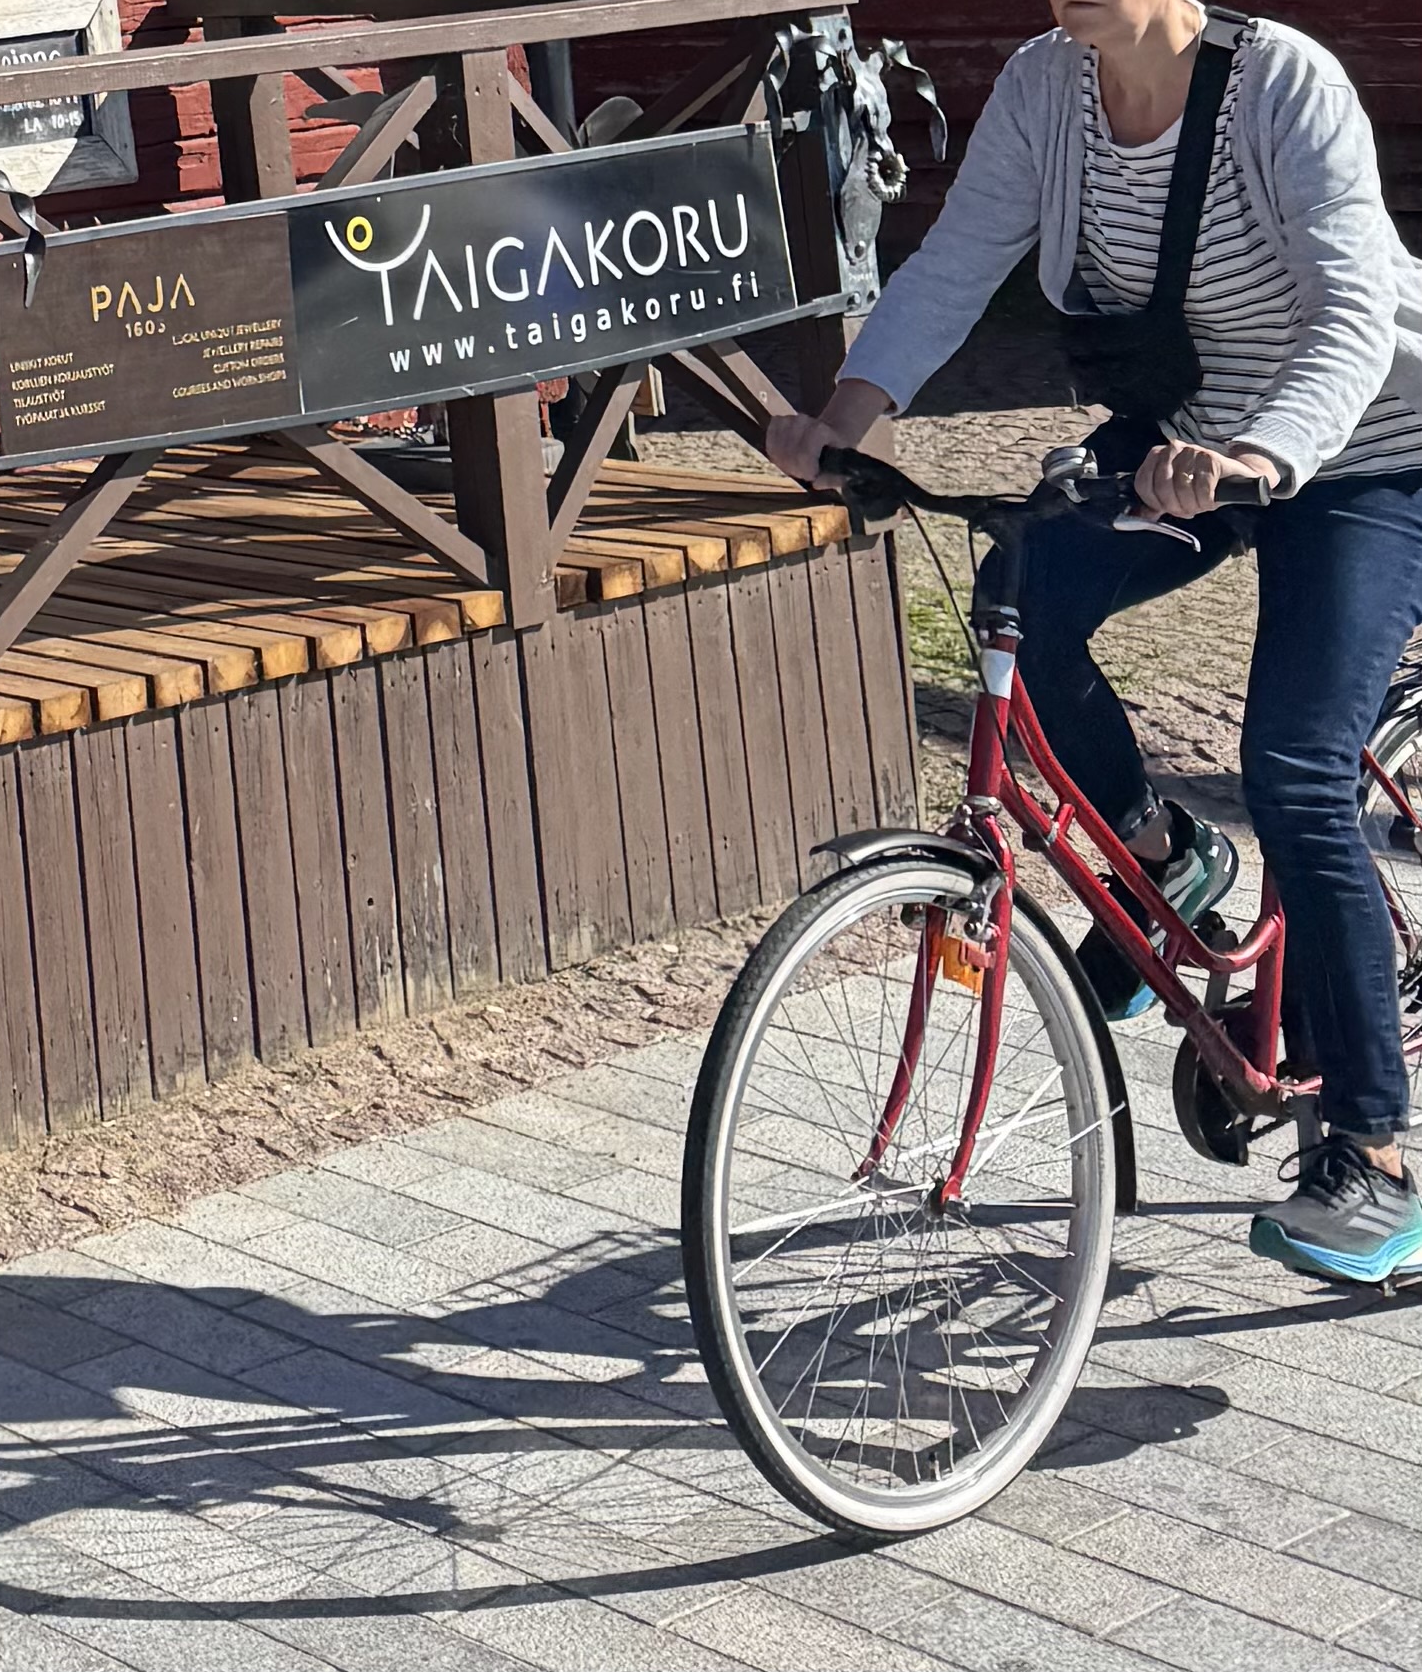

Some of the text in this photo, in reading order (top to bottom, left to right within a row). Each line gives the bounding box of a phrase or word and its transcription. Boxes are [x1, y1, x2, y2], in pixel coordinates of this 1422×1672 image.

[24, 117, 43, 134] LA
[90, 273, 196, 322] PAJA
[388, 270, 759, 373] www.taigakoru.fi
